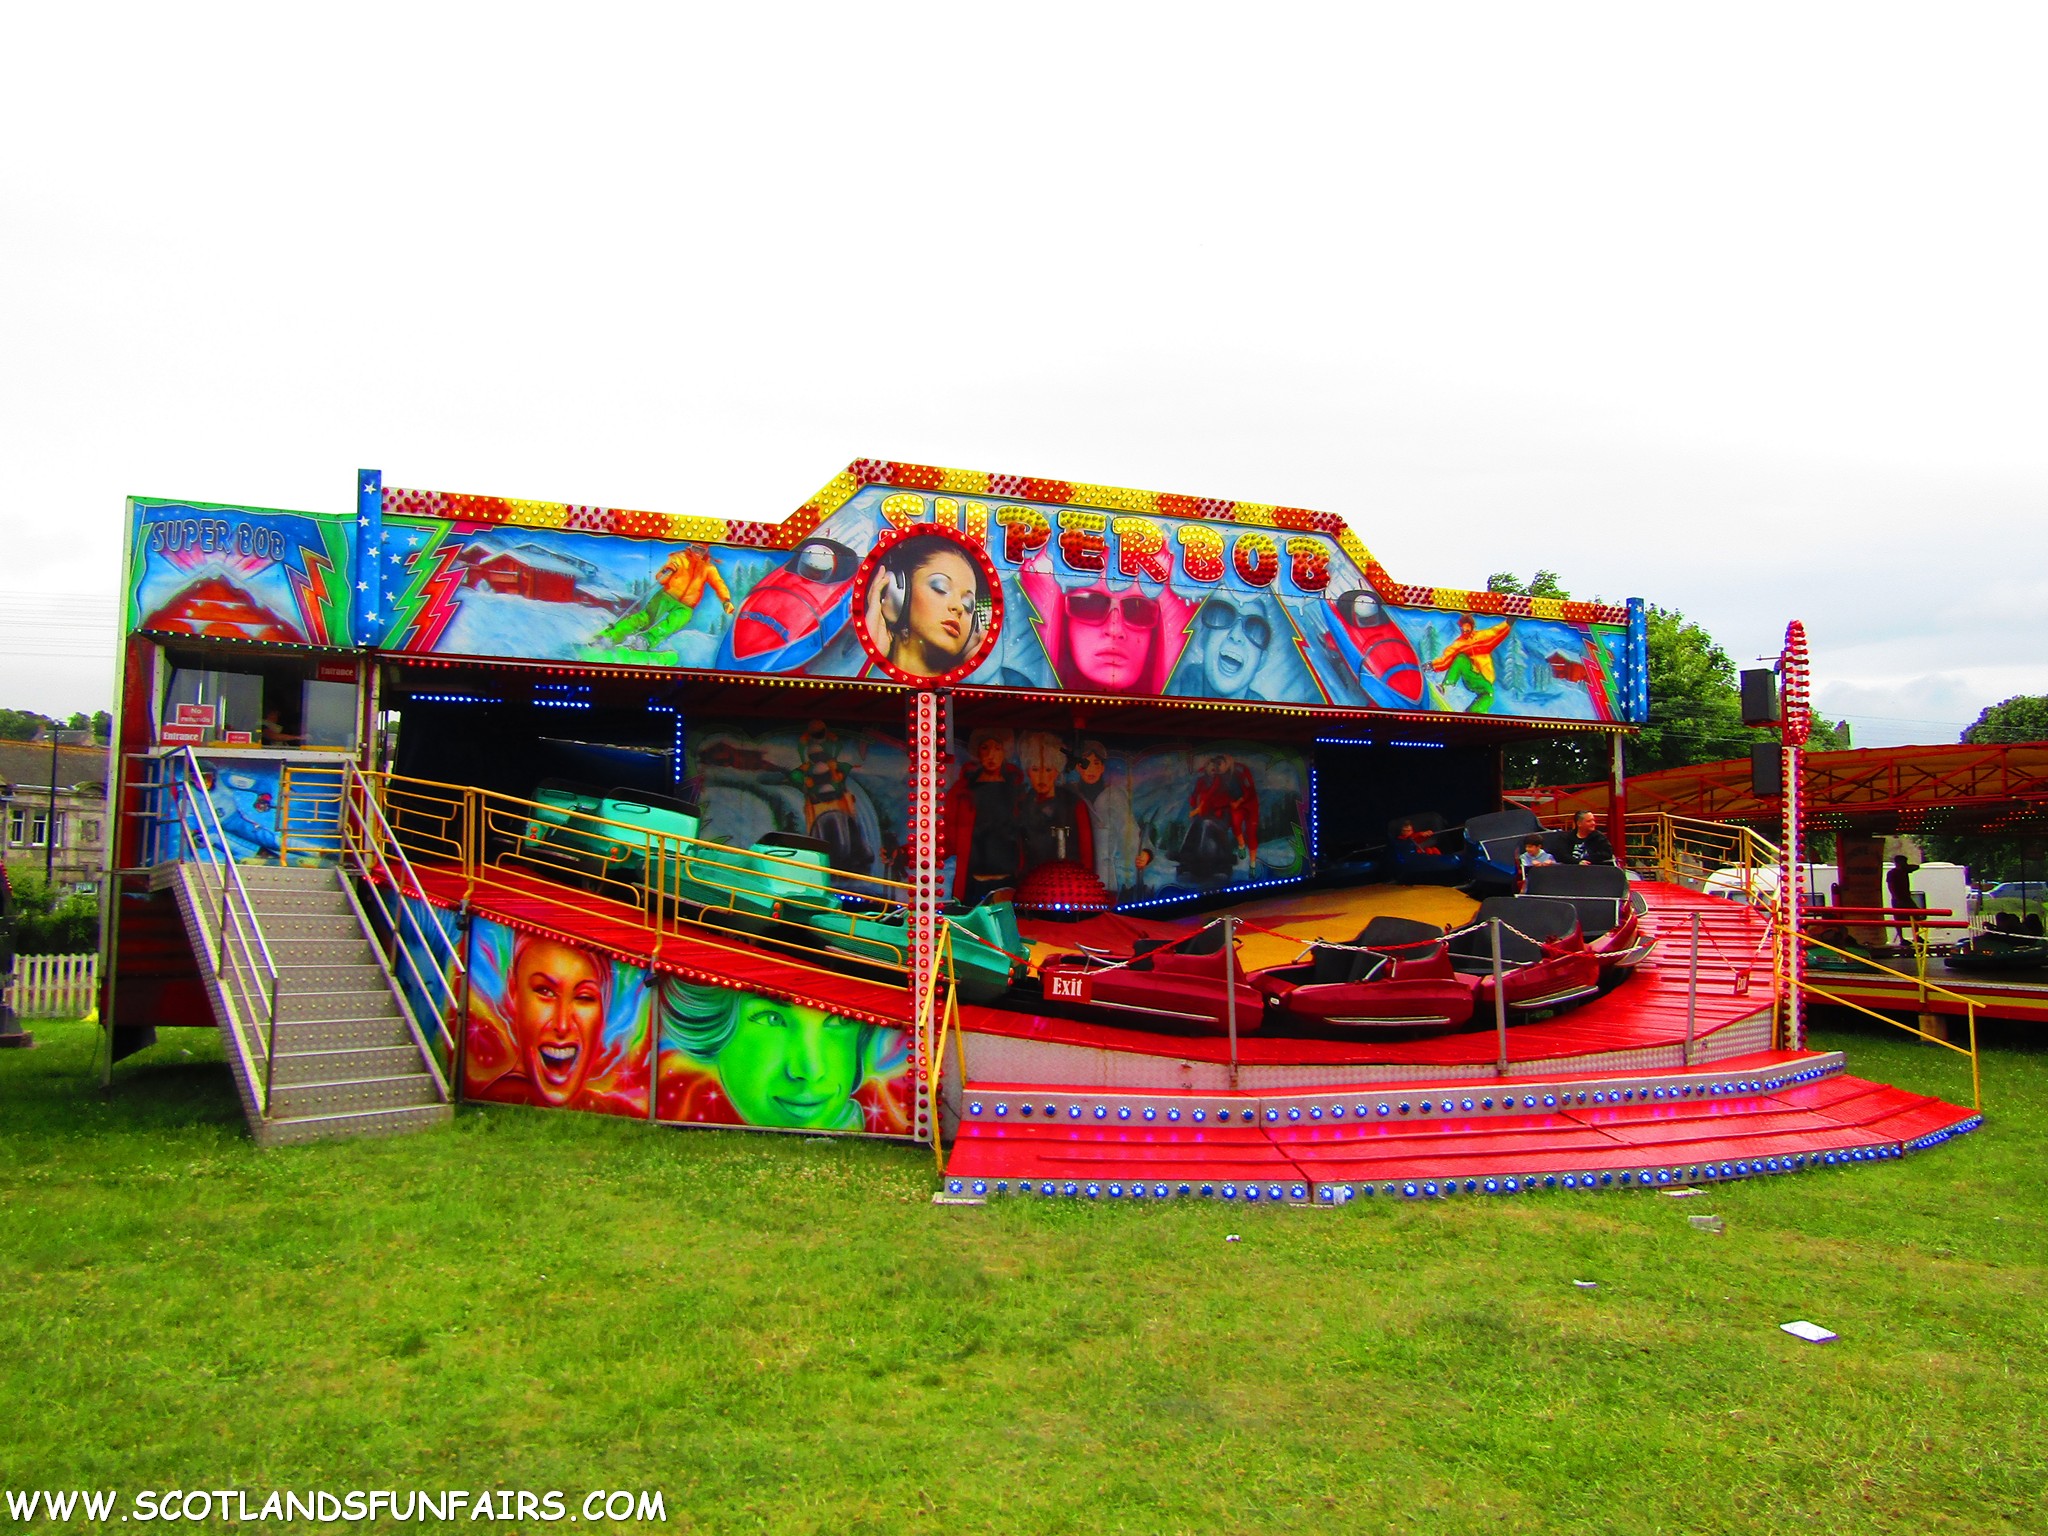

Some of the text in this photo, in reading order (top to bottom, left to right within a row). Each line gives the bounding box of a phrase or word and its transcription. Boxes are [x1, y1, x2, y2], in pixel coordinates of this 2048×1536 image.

[152, 518, 286, 561] SUPER BOB
[878, 493, 1331, 593] SUPERBOB
[320, 666, 354, 676] Entrance
[163, 731, 199, 741] Entrance
[1052, 976, 1083, 997] Exit
